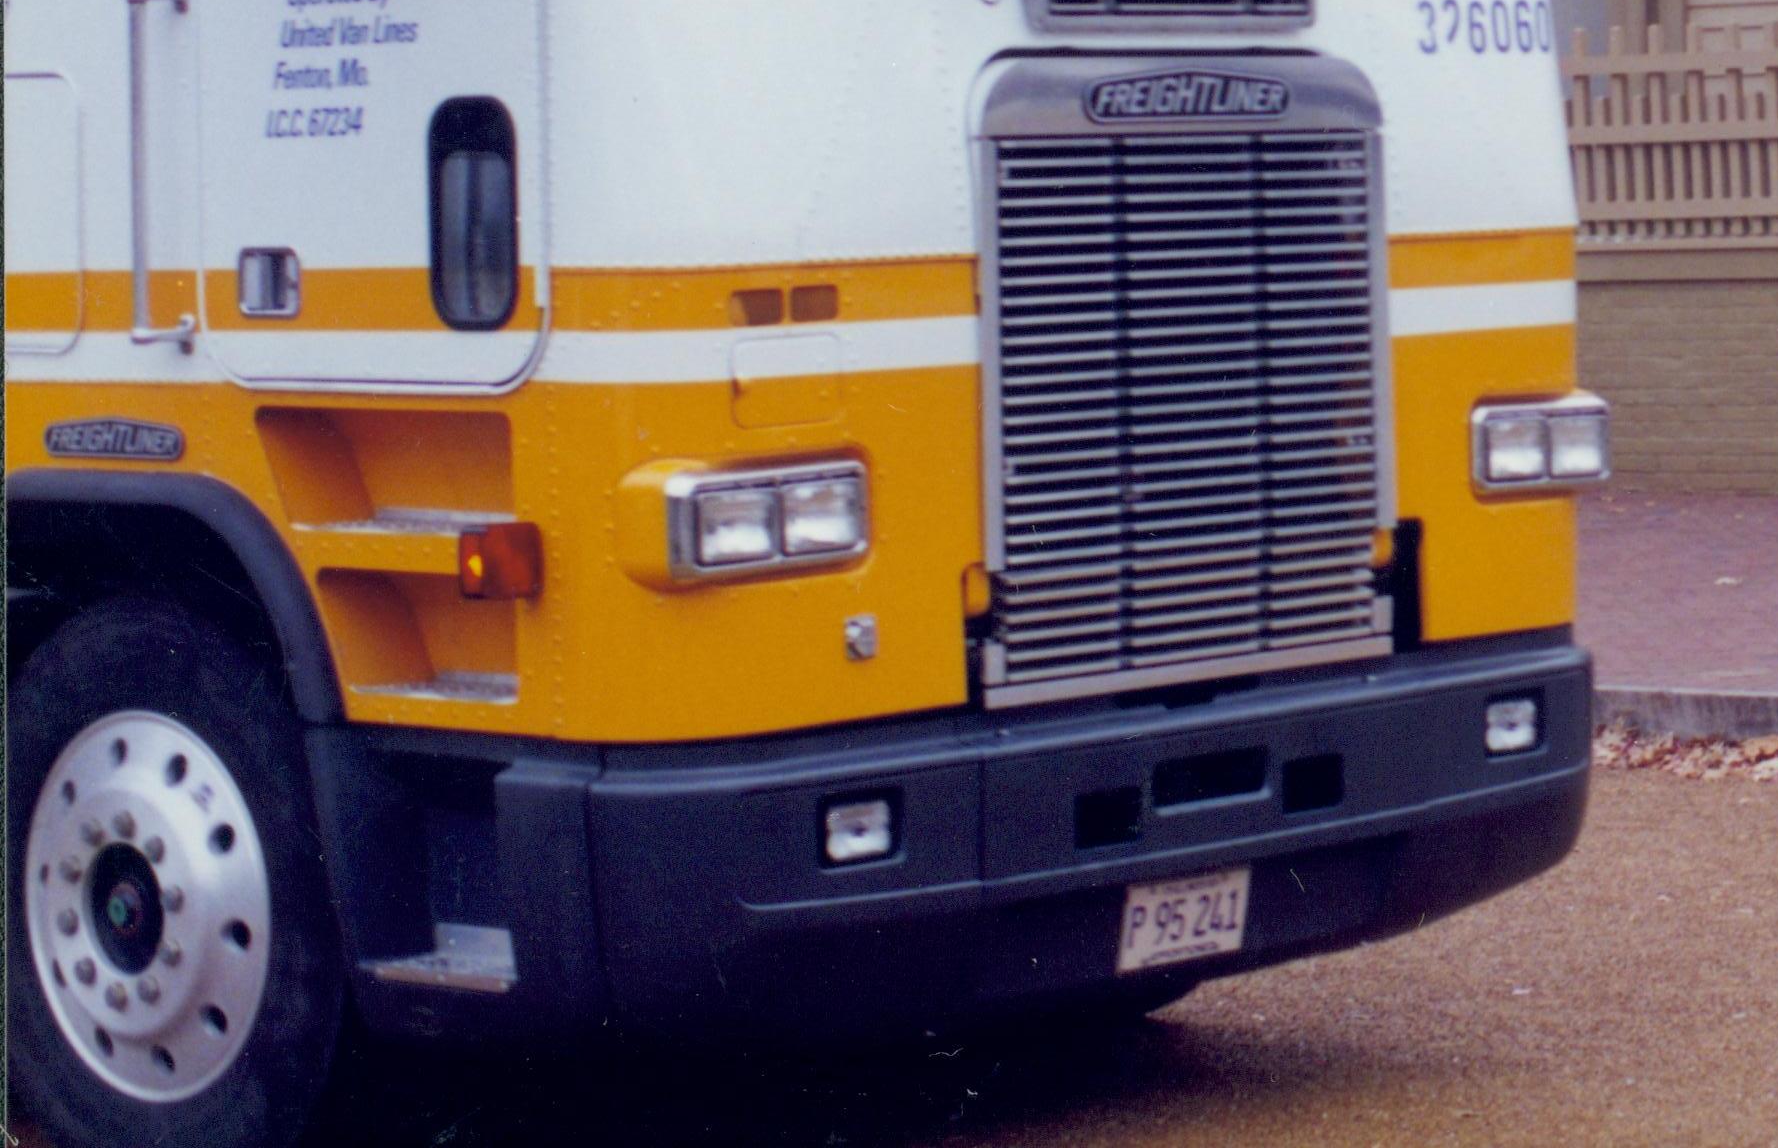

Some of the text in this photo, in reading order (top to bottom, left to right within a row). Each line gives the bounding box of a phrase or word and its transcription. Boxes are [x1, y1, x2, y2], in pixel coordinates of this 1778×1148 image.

[281, 14, 418, 48] United Van Lines
[1098, 69, 1286, 115] FREIGHTLINER
[307, 106, 364, 137] 67234
[50, 423, 178, 454] FREIGHTLINER
[1126, 905, 1147, 949] P
